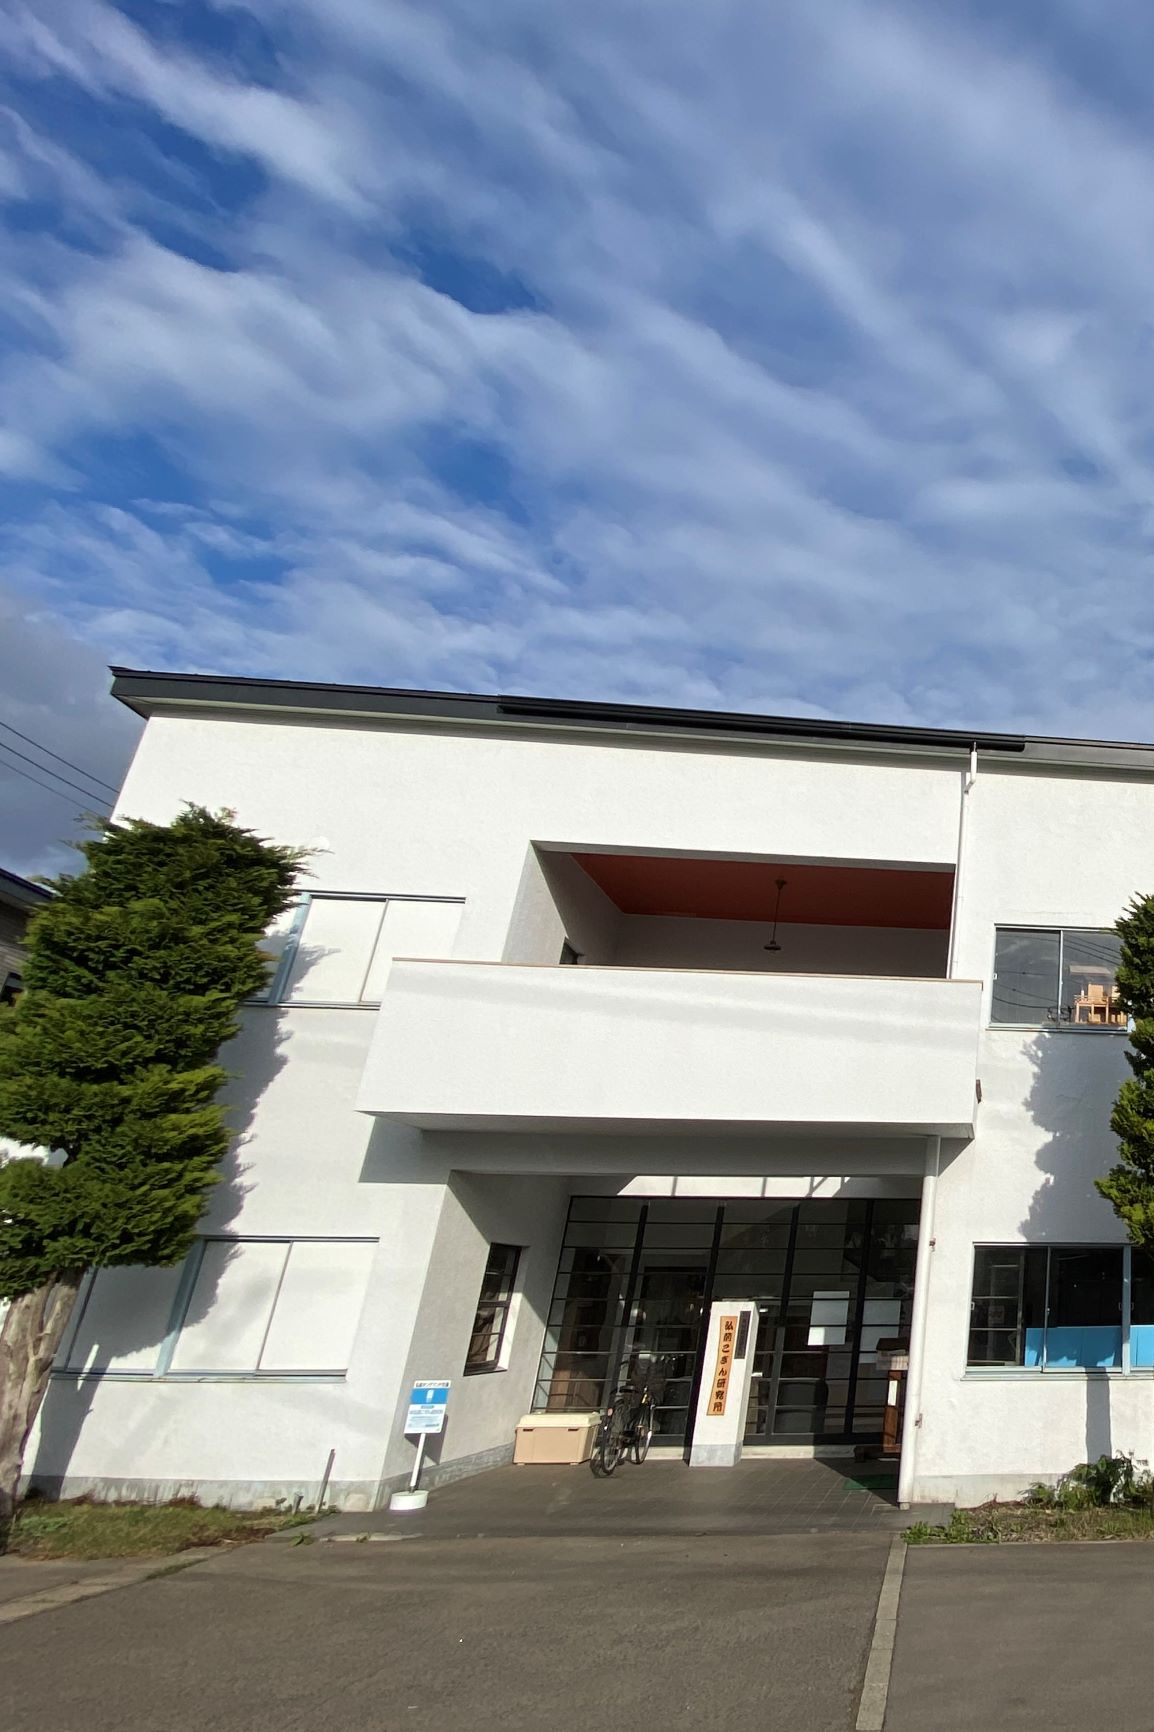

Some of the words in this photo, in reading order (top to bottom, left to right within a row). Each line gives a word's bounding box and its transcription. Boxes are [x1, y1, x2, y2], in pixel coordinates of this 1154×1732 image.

[712, 1320, 734, 1412] 弘前こぎん研究所
